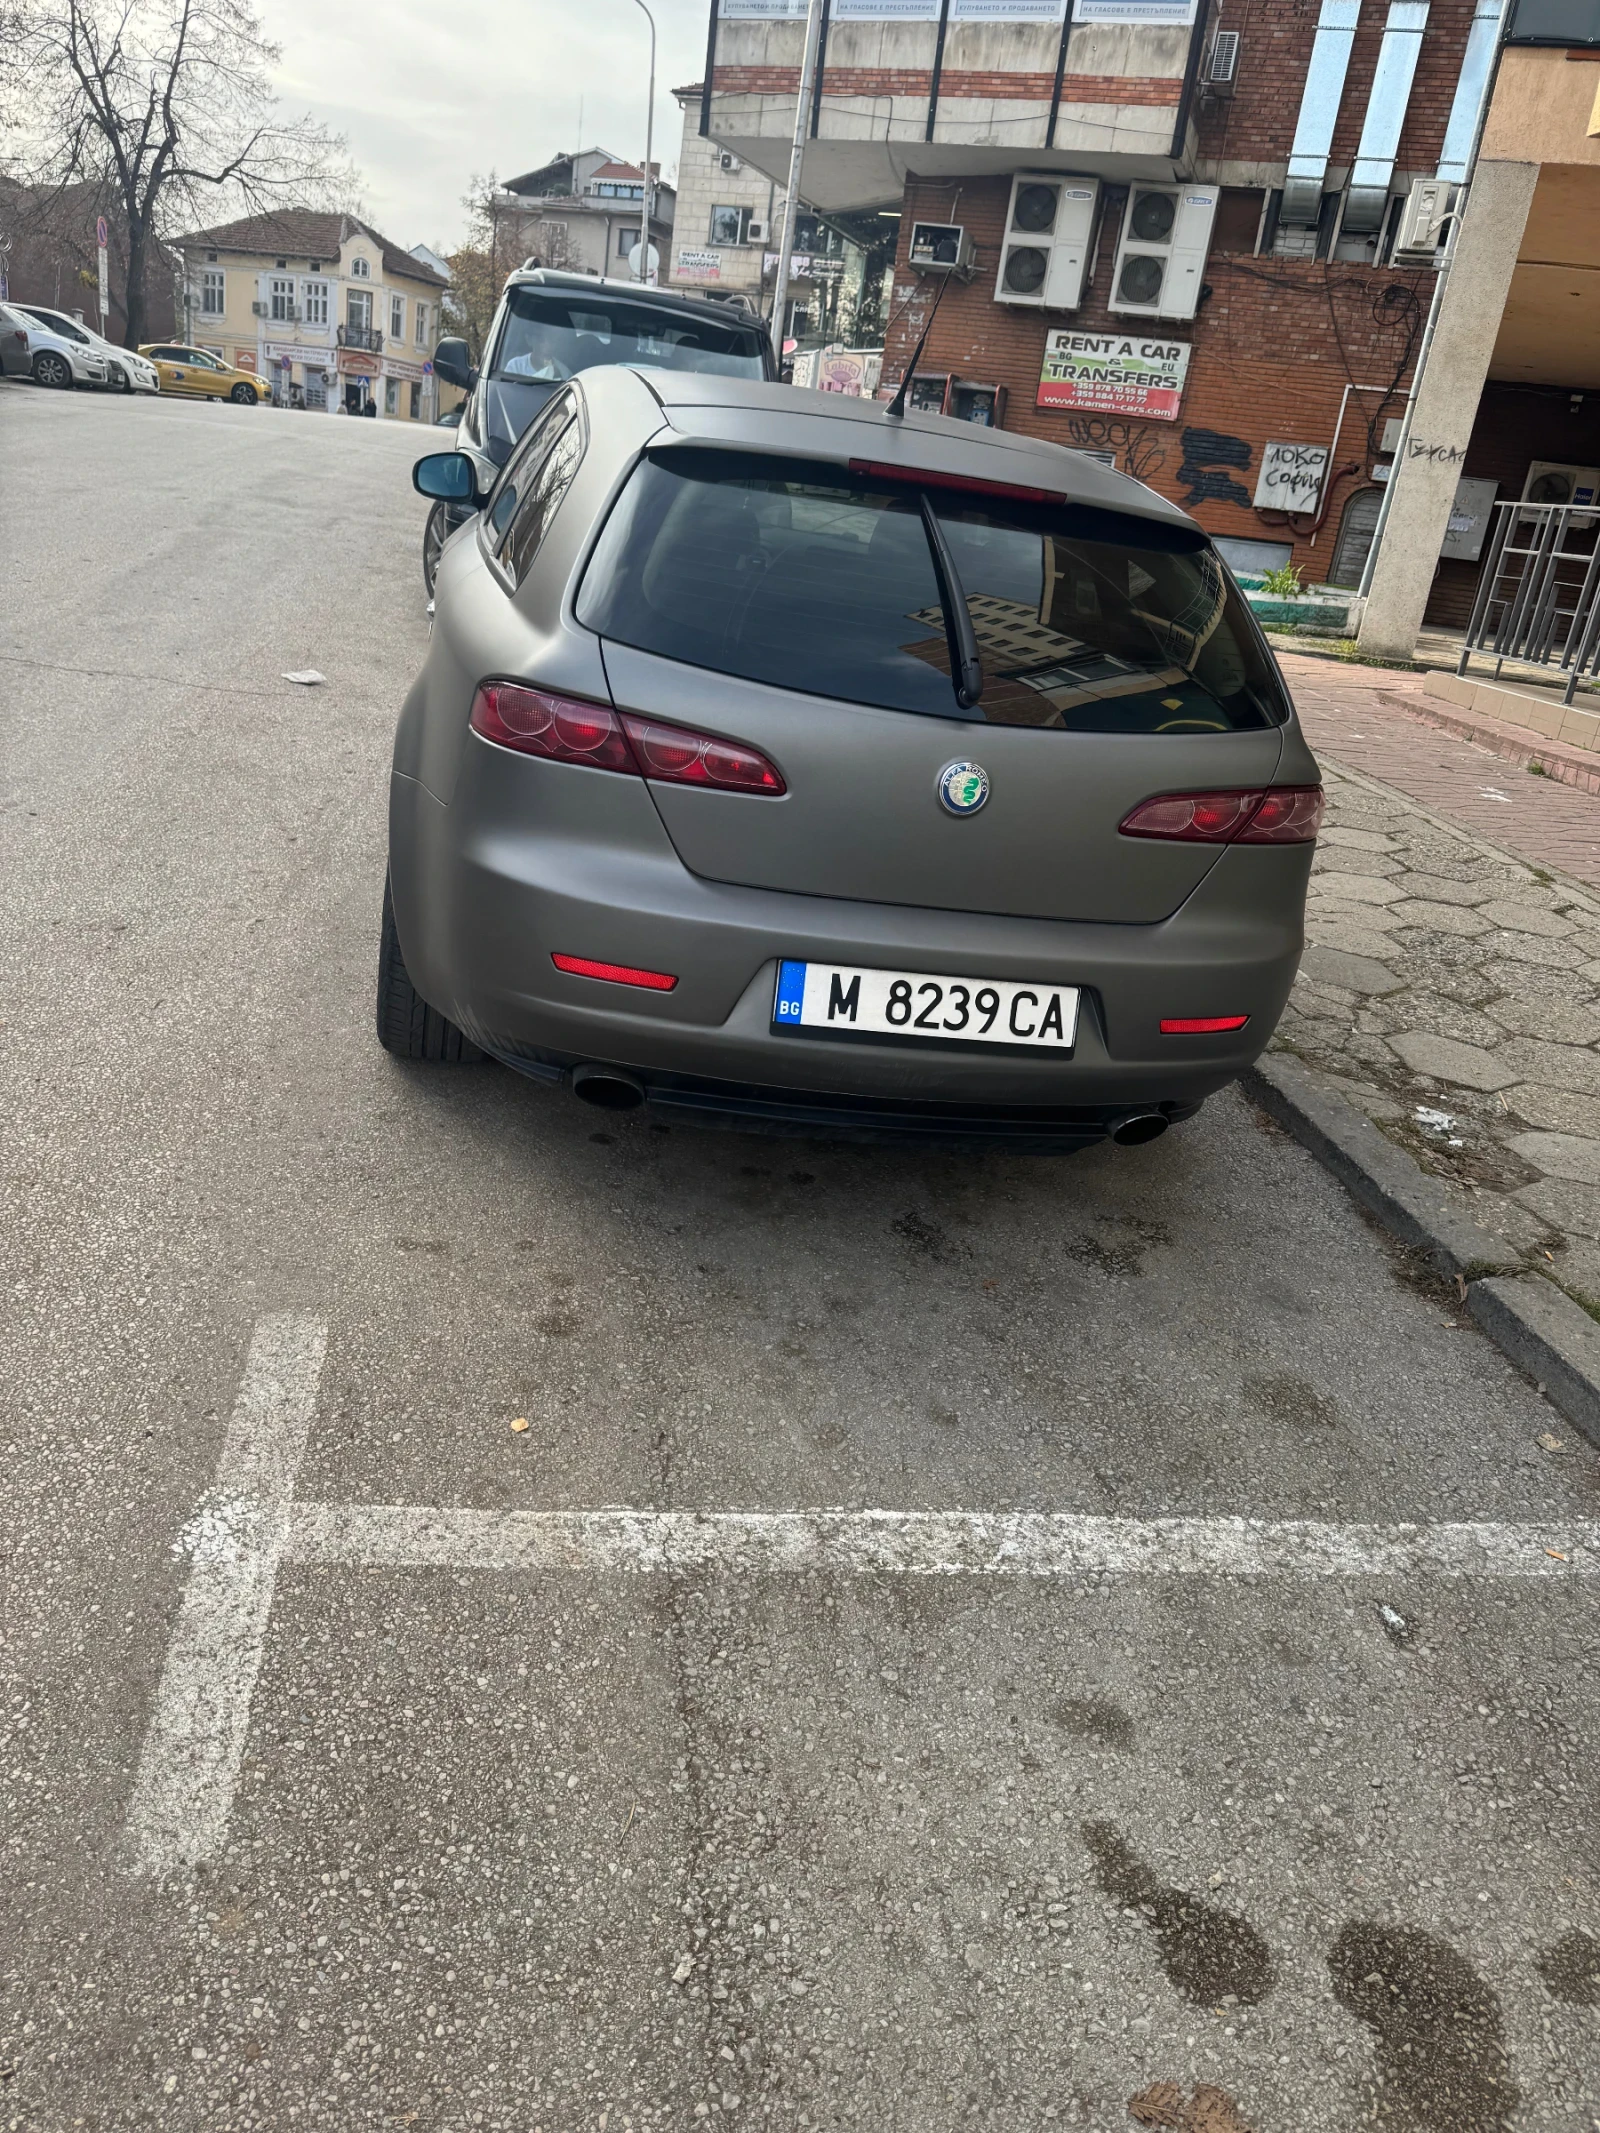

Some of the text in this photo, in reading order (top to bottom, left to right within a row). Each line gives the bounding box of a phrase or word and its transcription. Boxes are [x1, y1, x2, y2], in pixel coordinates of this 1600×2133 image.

[1133, 7, 1186, 15] ПРЕСТЪПЛЕНИЕ
[1055, 335, 1181, 361] RENT A CAR
[1059, 352, 1072, 361] BG
[1161, 363, 1175, 372] EU
[1049, 363, 1178, 389] TRANSFERS
[1072, 382, 1094, 390] +359
[1071, 390, 1094, 398] +359
[1095, 392, 1113, 400] 884
[1044, 396, 1171, 417] www.kamen-cars.com
[1575, 492, 1592, 500] Haier
[944, 764, 988, 792] ALFA ROMEO
[779, 1001, 800, 1016] BG
[827, 973, 1064, 1040] M 8239 CA
